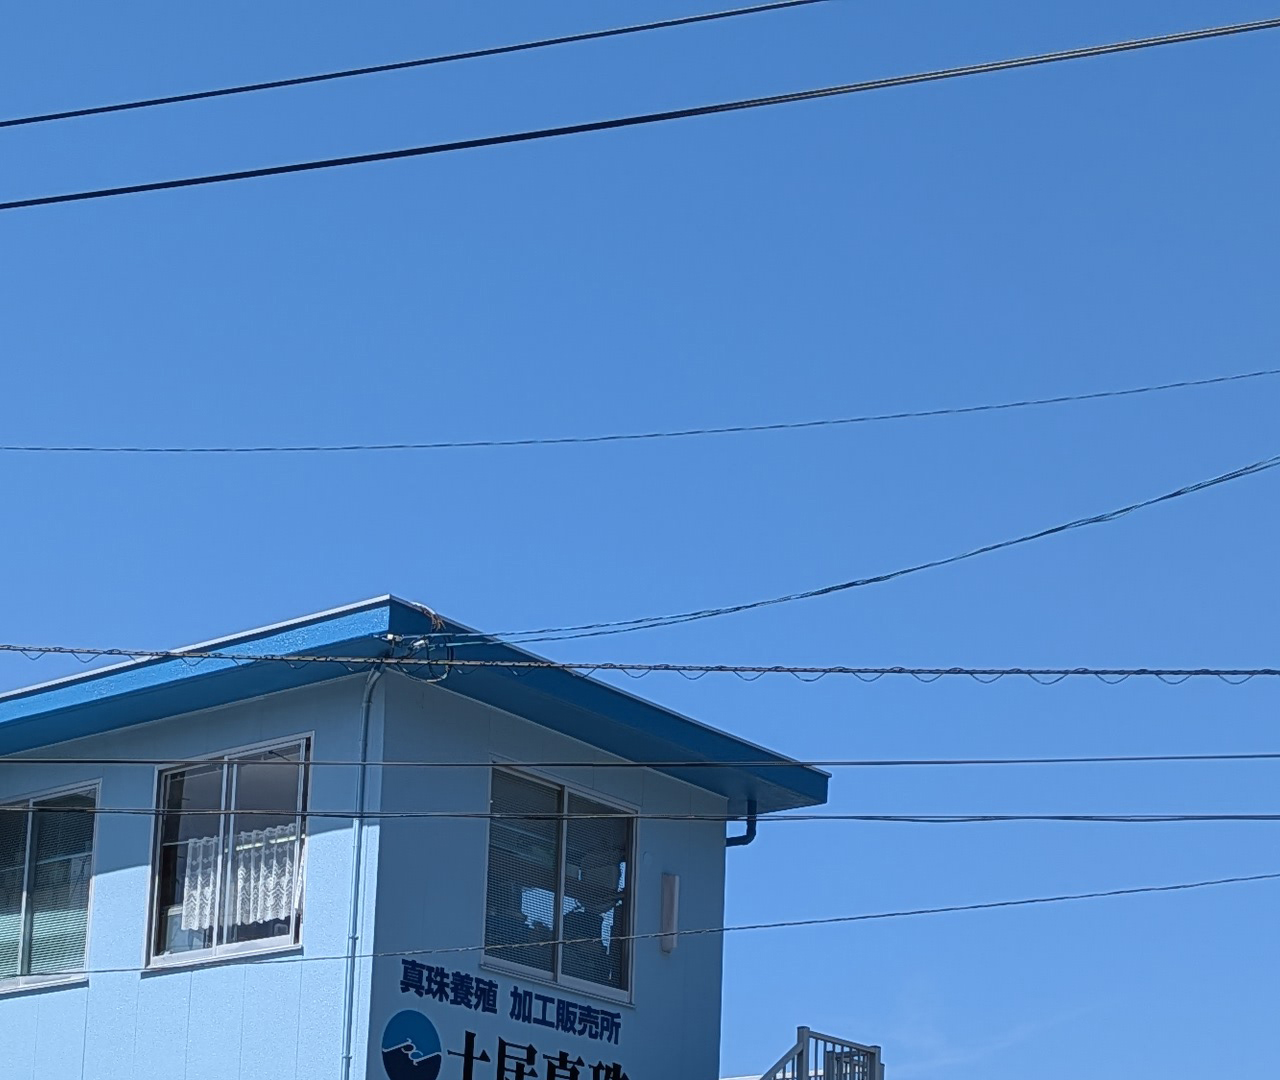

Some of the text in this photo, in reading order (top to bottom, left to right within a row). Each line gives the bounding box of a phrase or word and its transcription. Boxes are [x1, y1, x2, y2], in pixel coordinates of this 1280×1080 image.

[400, 958, 622, 1045] 真珠養殖 加工販売所
